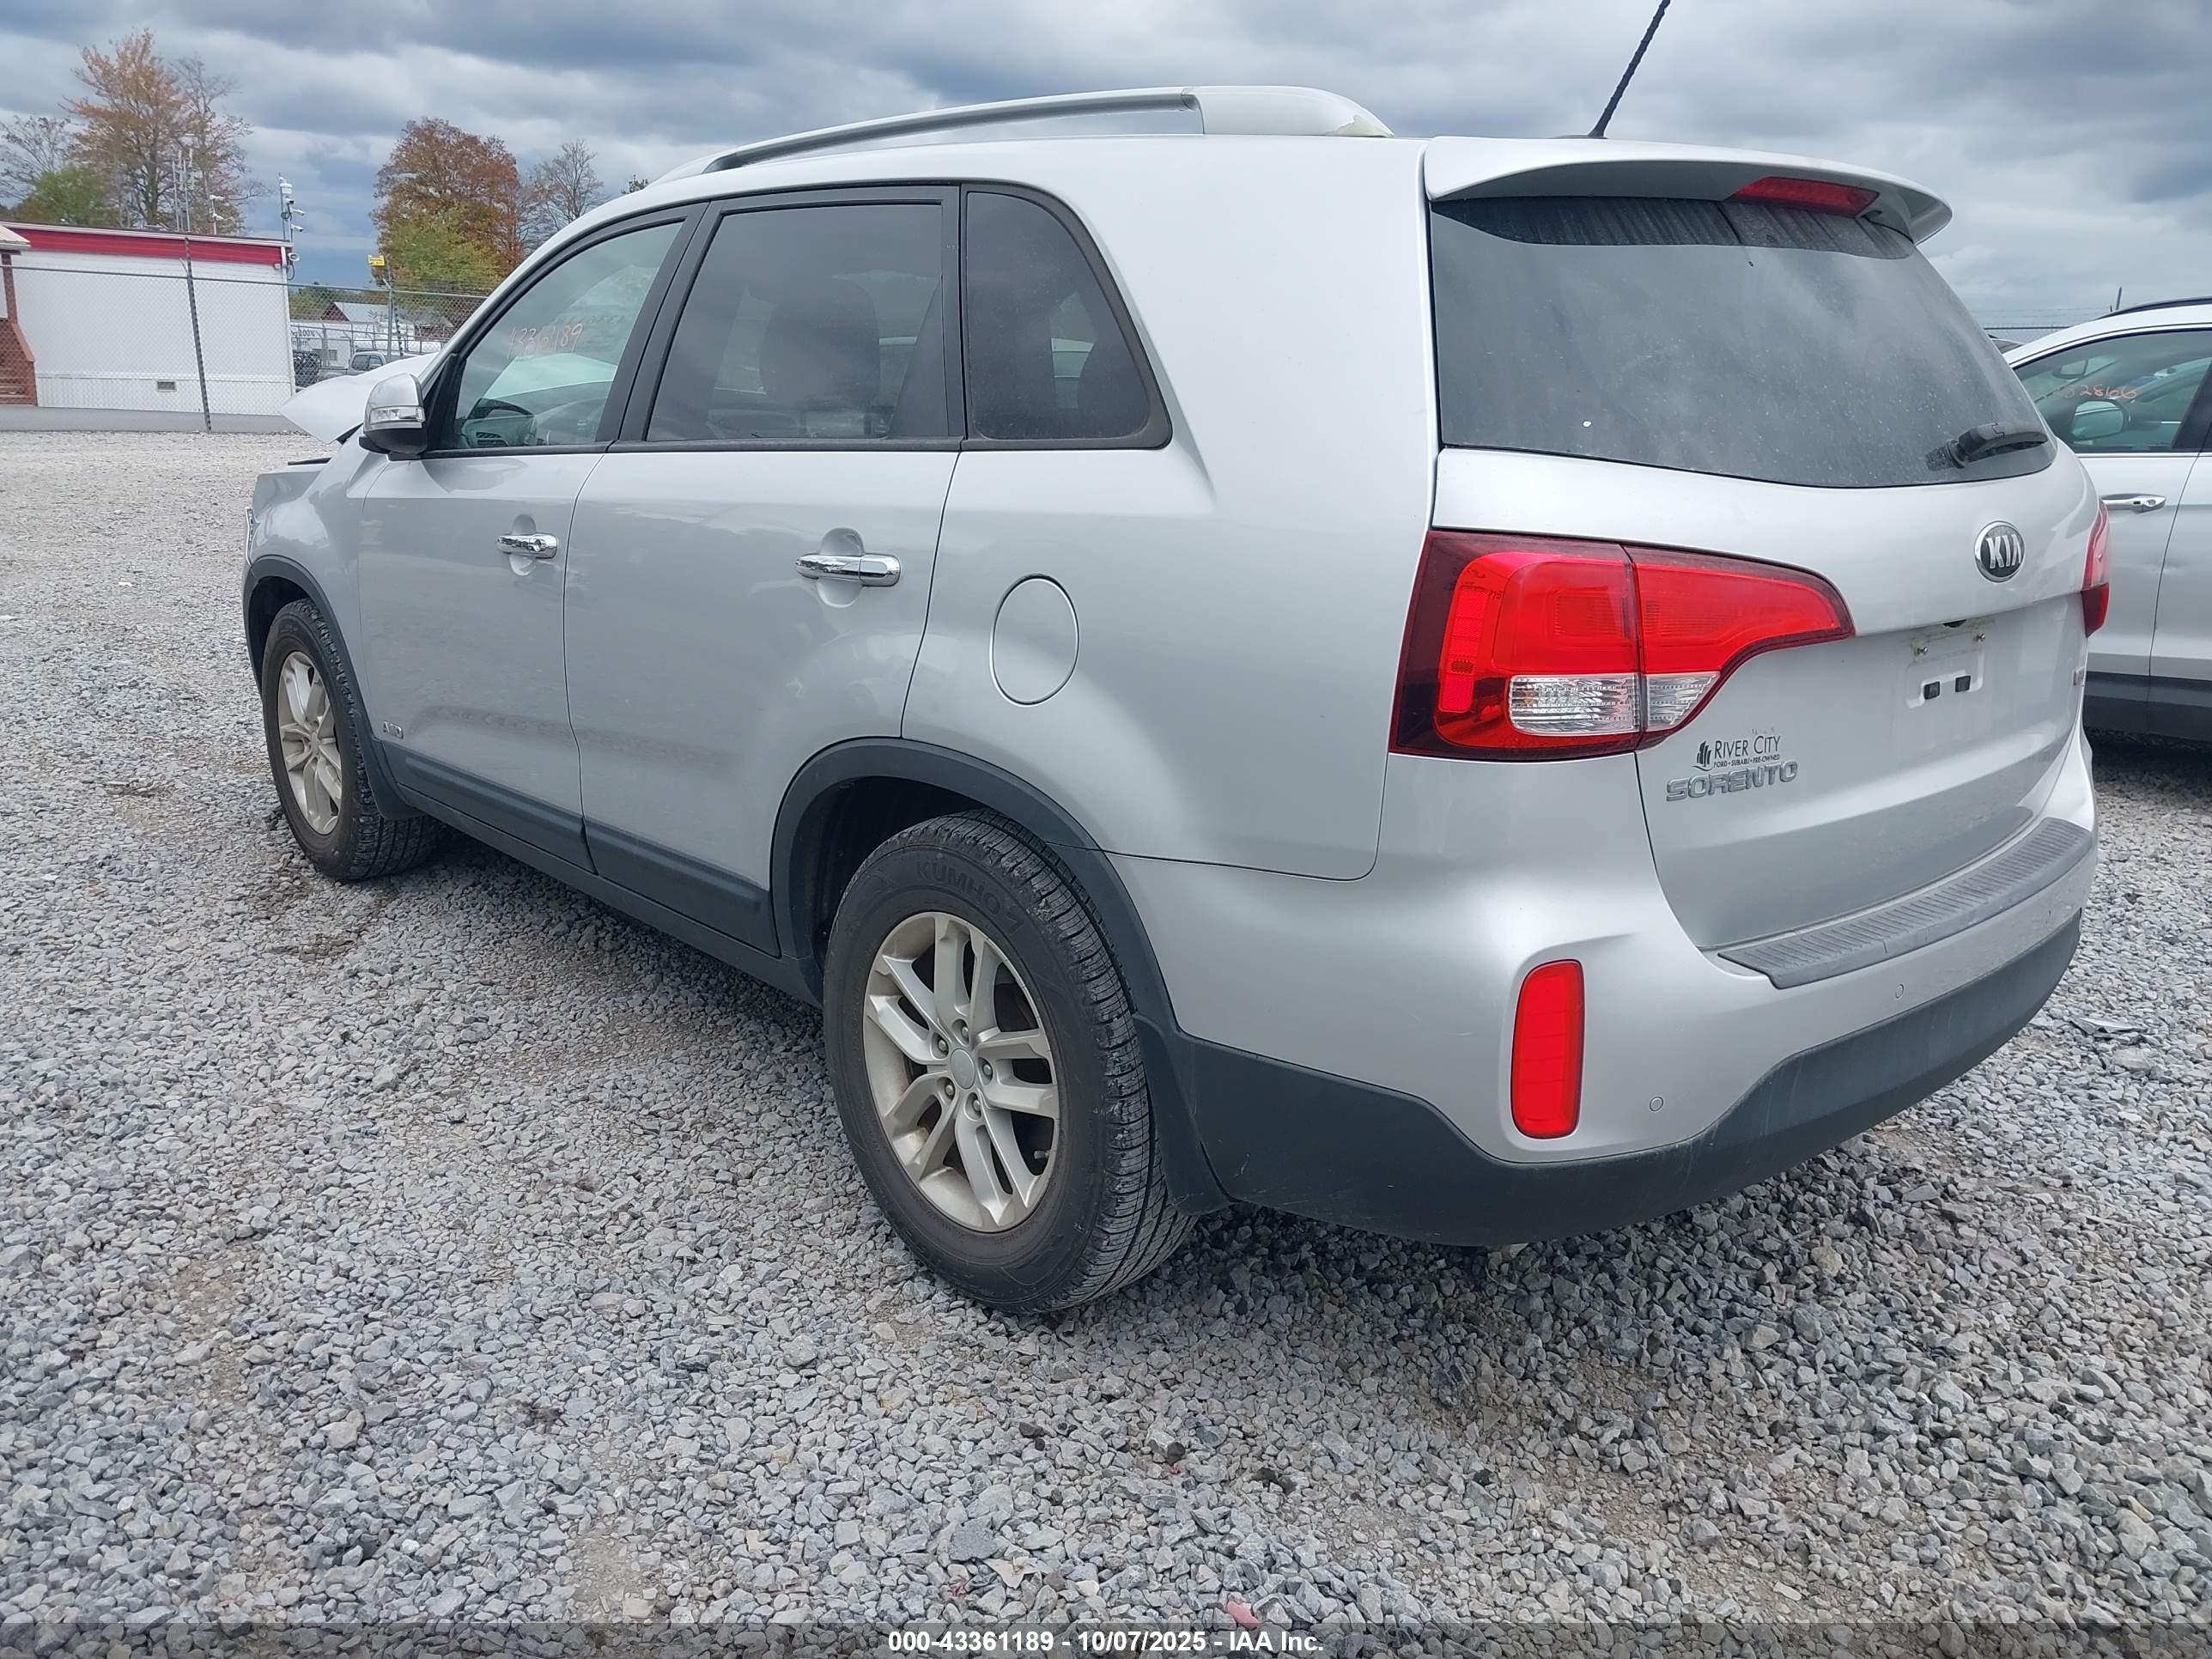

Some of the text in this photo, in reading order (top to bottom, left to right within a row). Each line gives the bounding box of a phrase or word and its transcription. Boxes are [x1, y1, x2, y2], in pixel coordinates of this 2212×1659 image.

[1985, 533, 2021, 569] KIA
[1713, 760, 1728, 769] FORD
[1730, 757, 1750, 767] SUBARU
[1714, 735, 1781, 759] RIVER CITY
[1666, 760, 1798, 801] SORENTO
[915, 860, 1001, 915] KUMHO
